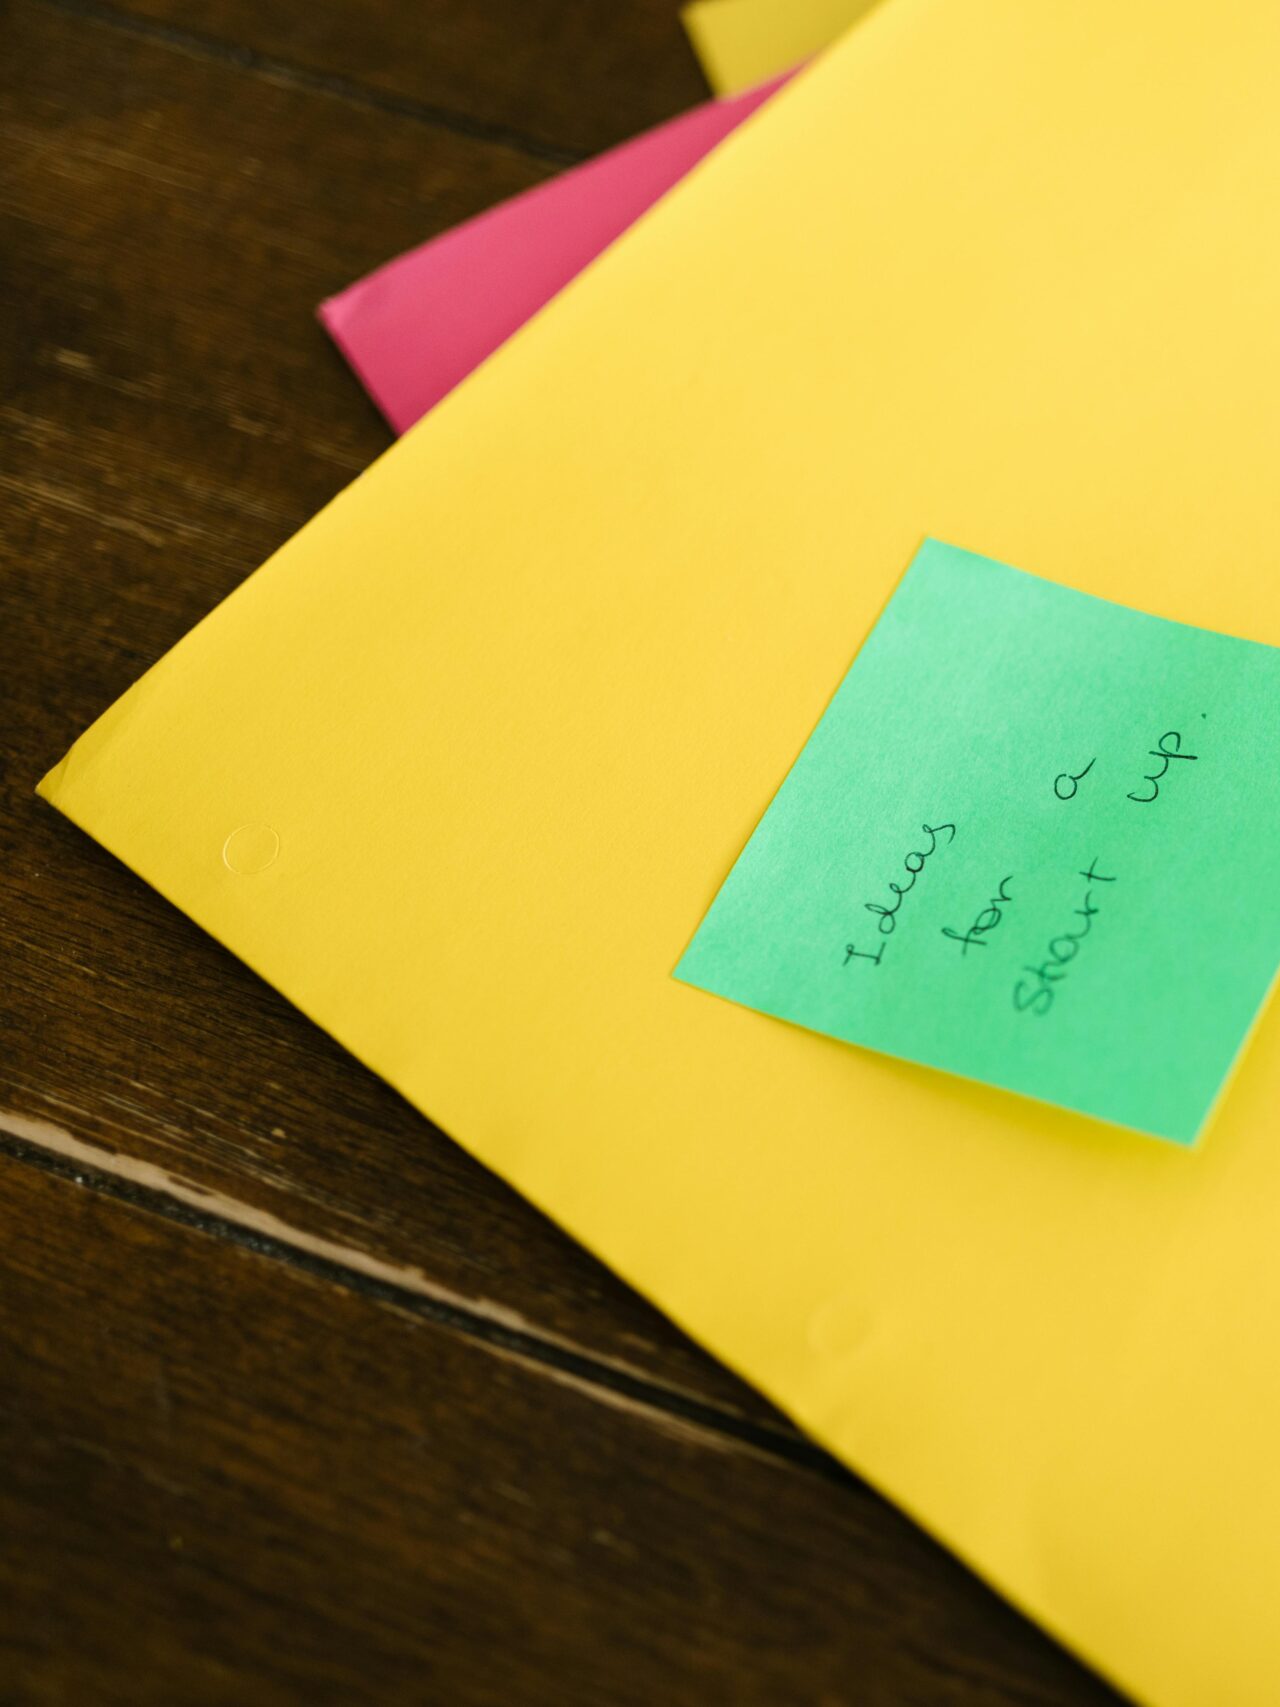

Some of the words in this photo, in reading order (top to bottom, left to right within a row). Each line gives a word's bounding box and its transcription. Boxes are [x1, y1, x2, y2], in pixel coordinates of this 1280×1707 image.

[843, 823, 957, 968] Ideas
[941, 875, 1014, 957] for
[1053, 757, 1097, 801] a
